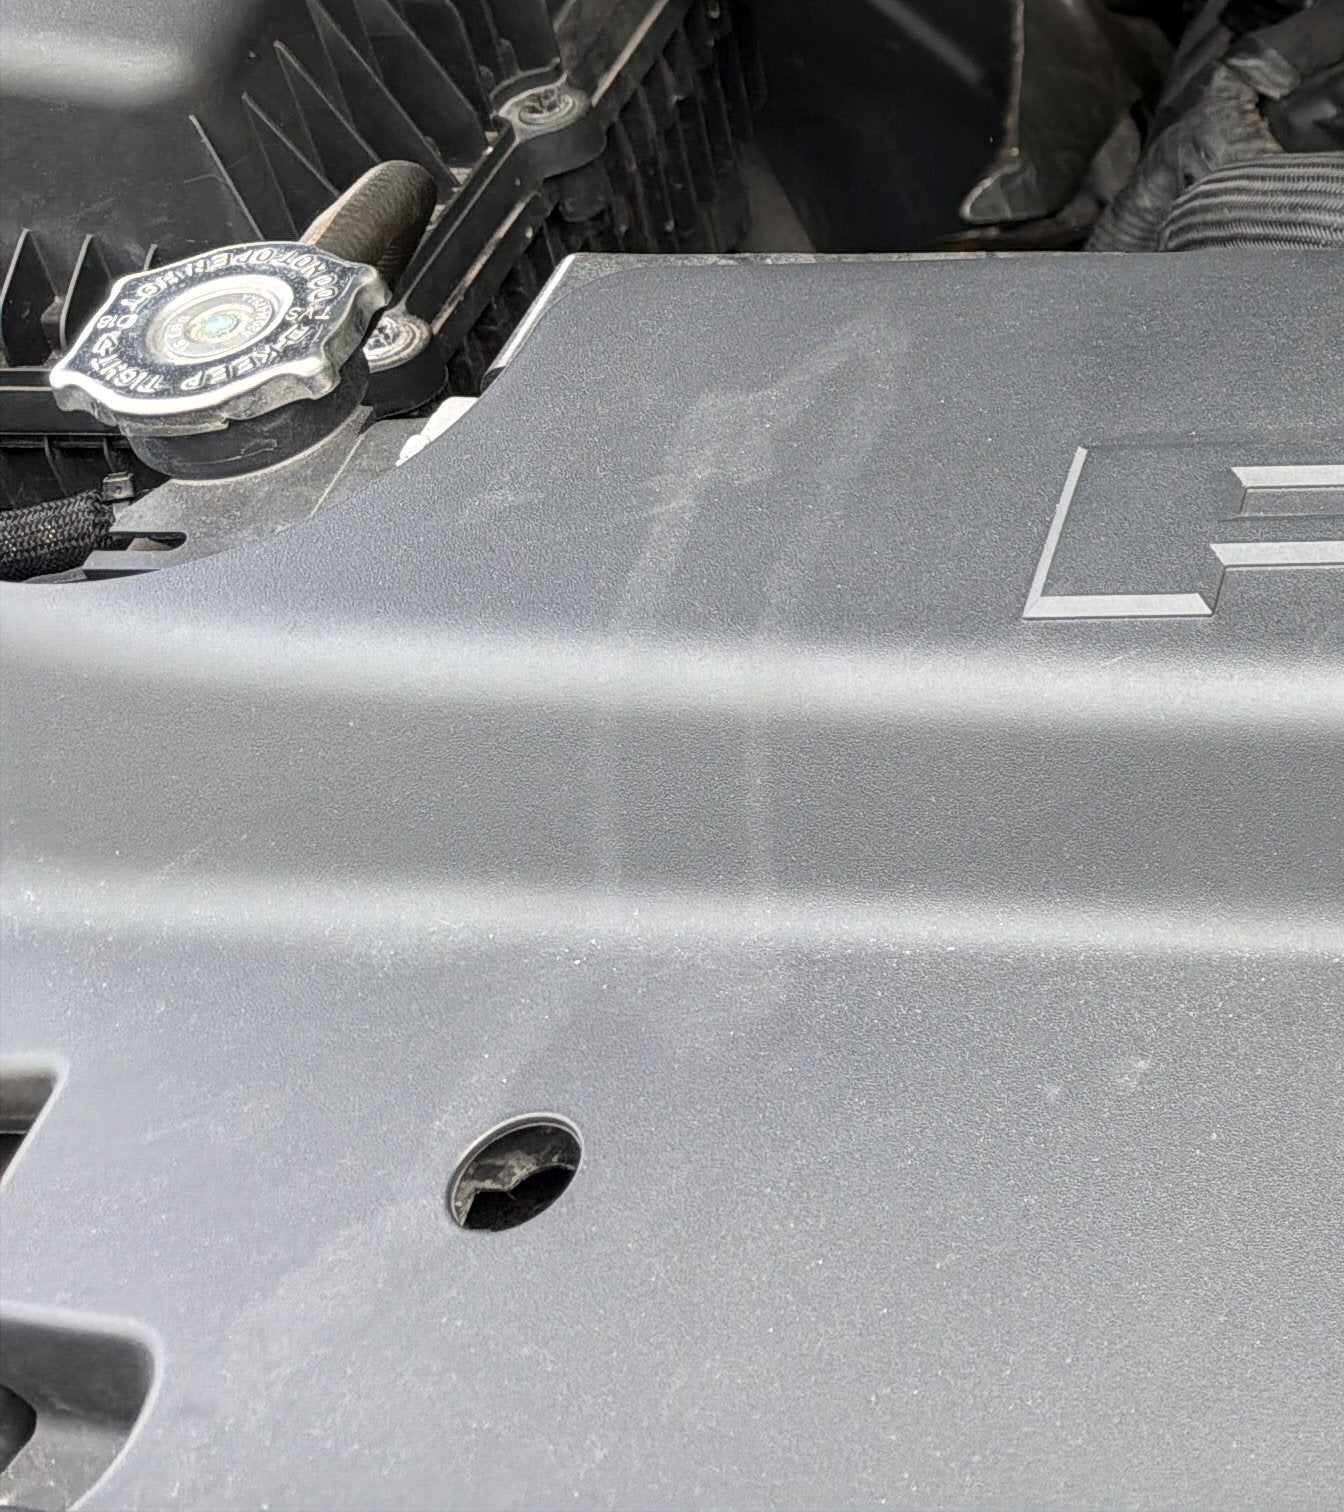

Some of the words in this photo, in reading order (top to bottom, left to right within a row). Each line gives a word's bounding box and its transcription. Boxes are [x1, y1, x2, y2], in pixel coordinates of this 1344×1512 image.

[285, 306, 332, 321] TVS
[91, 354, 165, 393] TIGHT
[181, 345, 280, 390] KEEP
